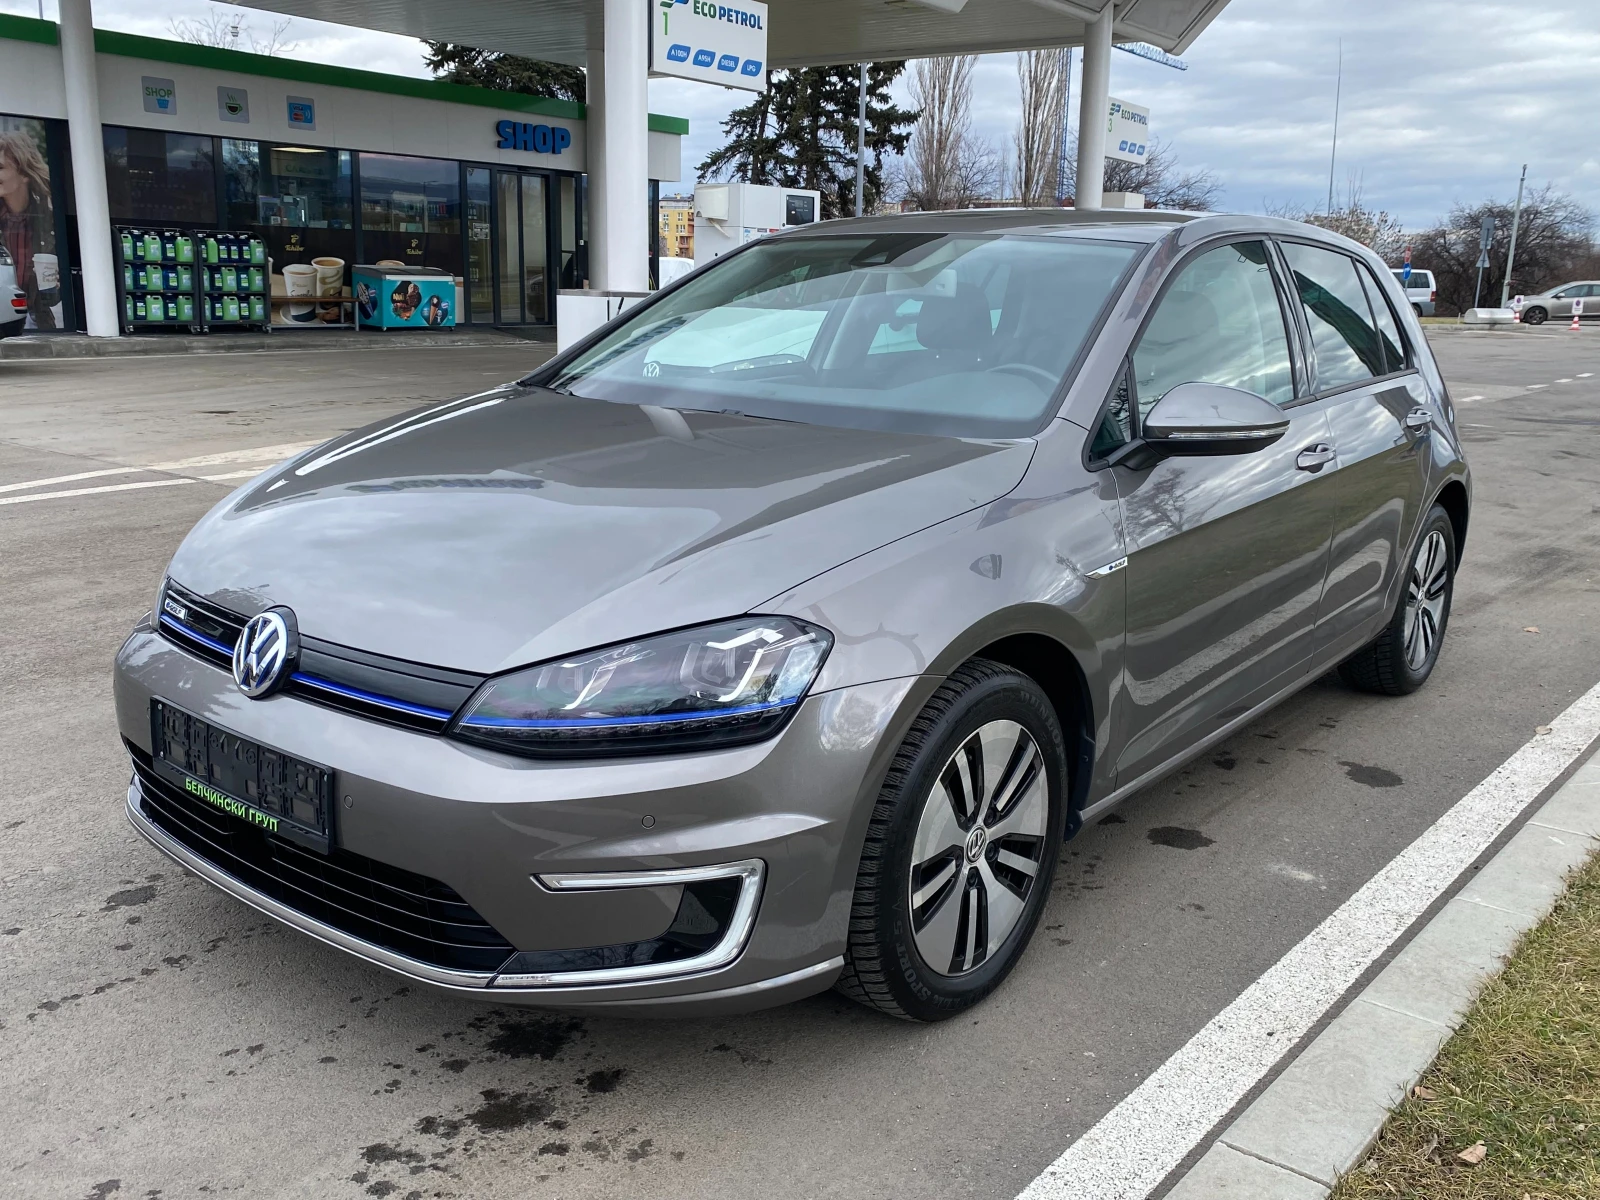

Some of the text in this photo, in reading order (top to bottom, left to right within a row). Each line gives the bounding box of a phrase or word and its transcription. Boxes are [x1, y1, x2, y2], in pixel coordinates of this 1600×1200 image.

[662, 11, 668, 35] 1
[721, 58, 735, 68] DIESEL
[746, 64, 756, 72] LPG
[145, 86, 173, 98] SHOP
[495, 119, 571, 154] SHOP
[1108, 118, 1112, 132] 3
[1020, 690, 1065, 759] DUNLOP
[185, 776, 280, 832] БЕЛЧИНСКИ ГРУП
[896, 941, 932, 1003] SPORT
